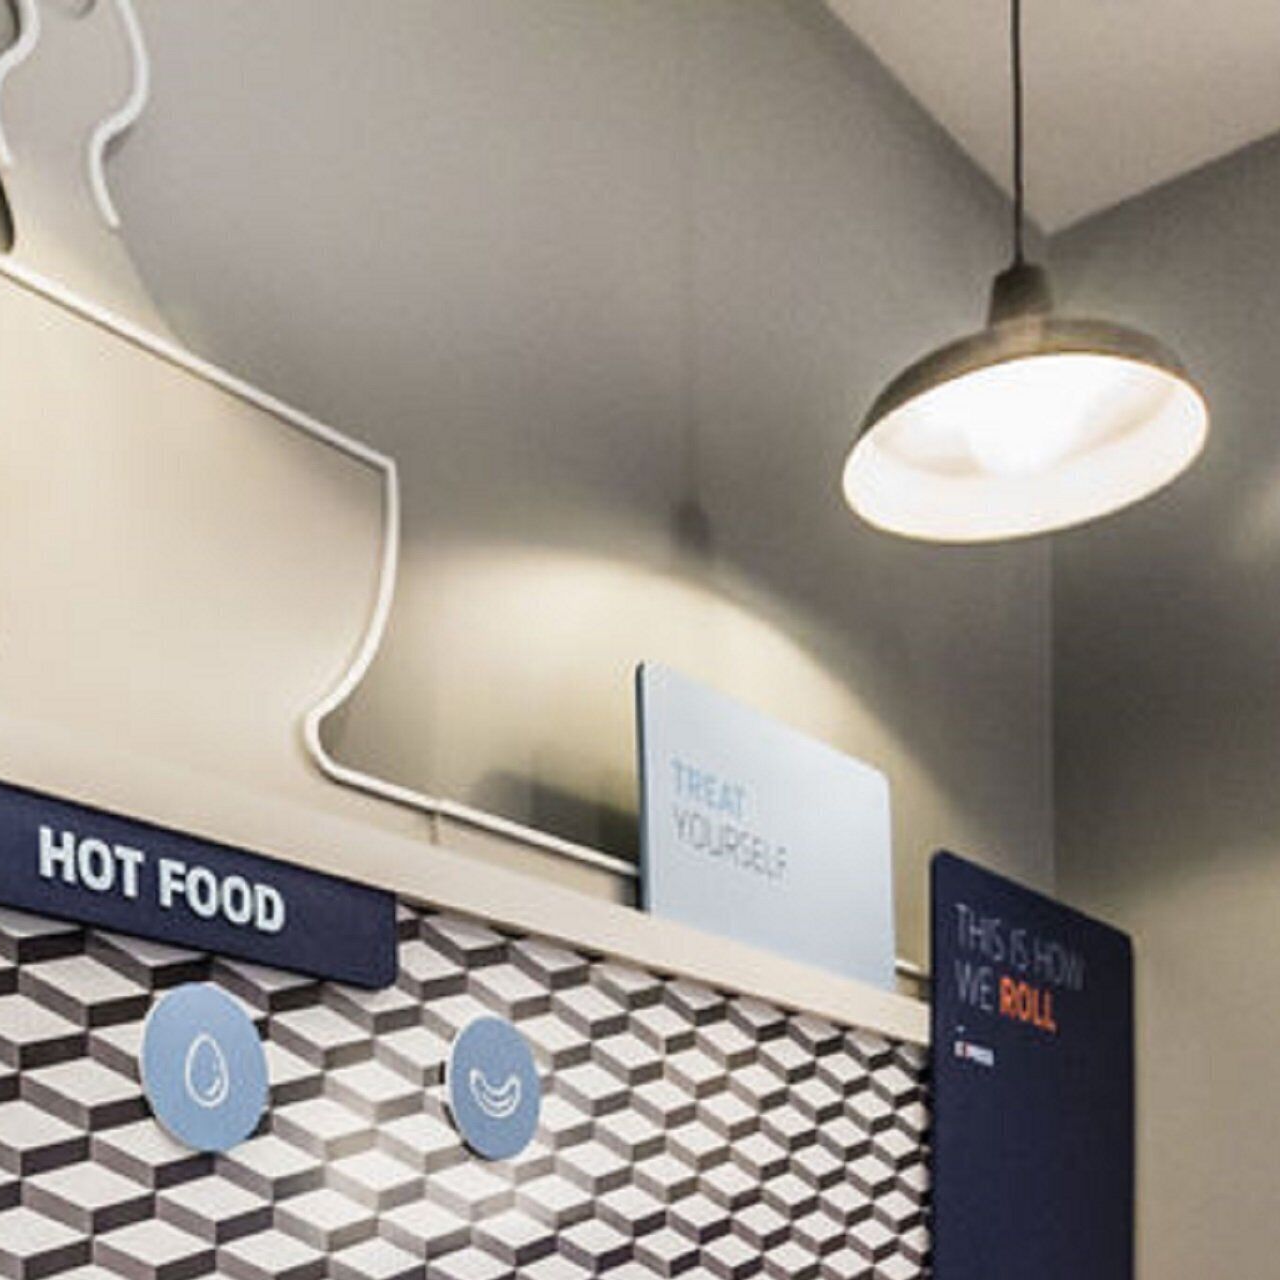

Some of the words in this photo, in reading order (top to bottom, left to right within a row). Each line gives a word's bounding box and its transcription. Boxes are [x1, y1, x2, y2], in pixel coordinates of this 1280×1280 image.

[670, 758, 746, 819] TREAT
[38, 824, 145, 899] HOT
[157, 858, 287, 934] FOOD
[671, 803, 788, 880] YOURSELF
[955, 903, 1005, 962] THIS
[1033, 937, 1086, 991] HOW
[955, 960, 993, 1012] WE
[999, 974, 1058, 1034] ROLL
